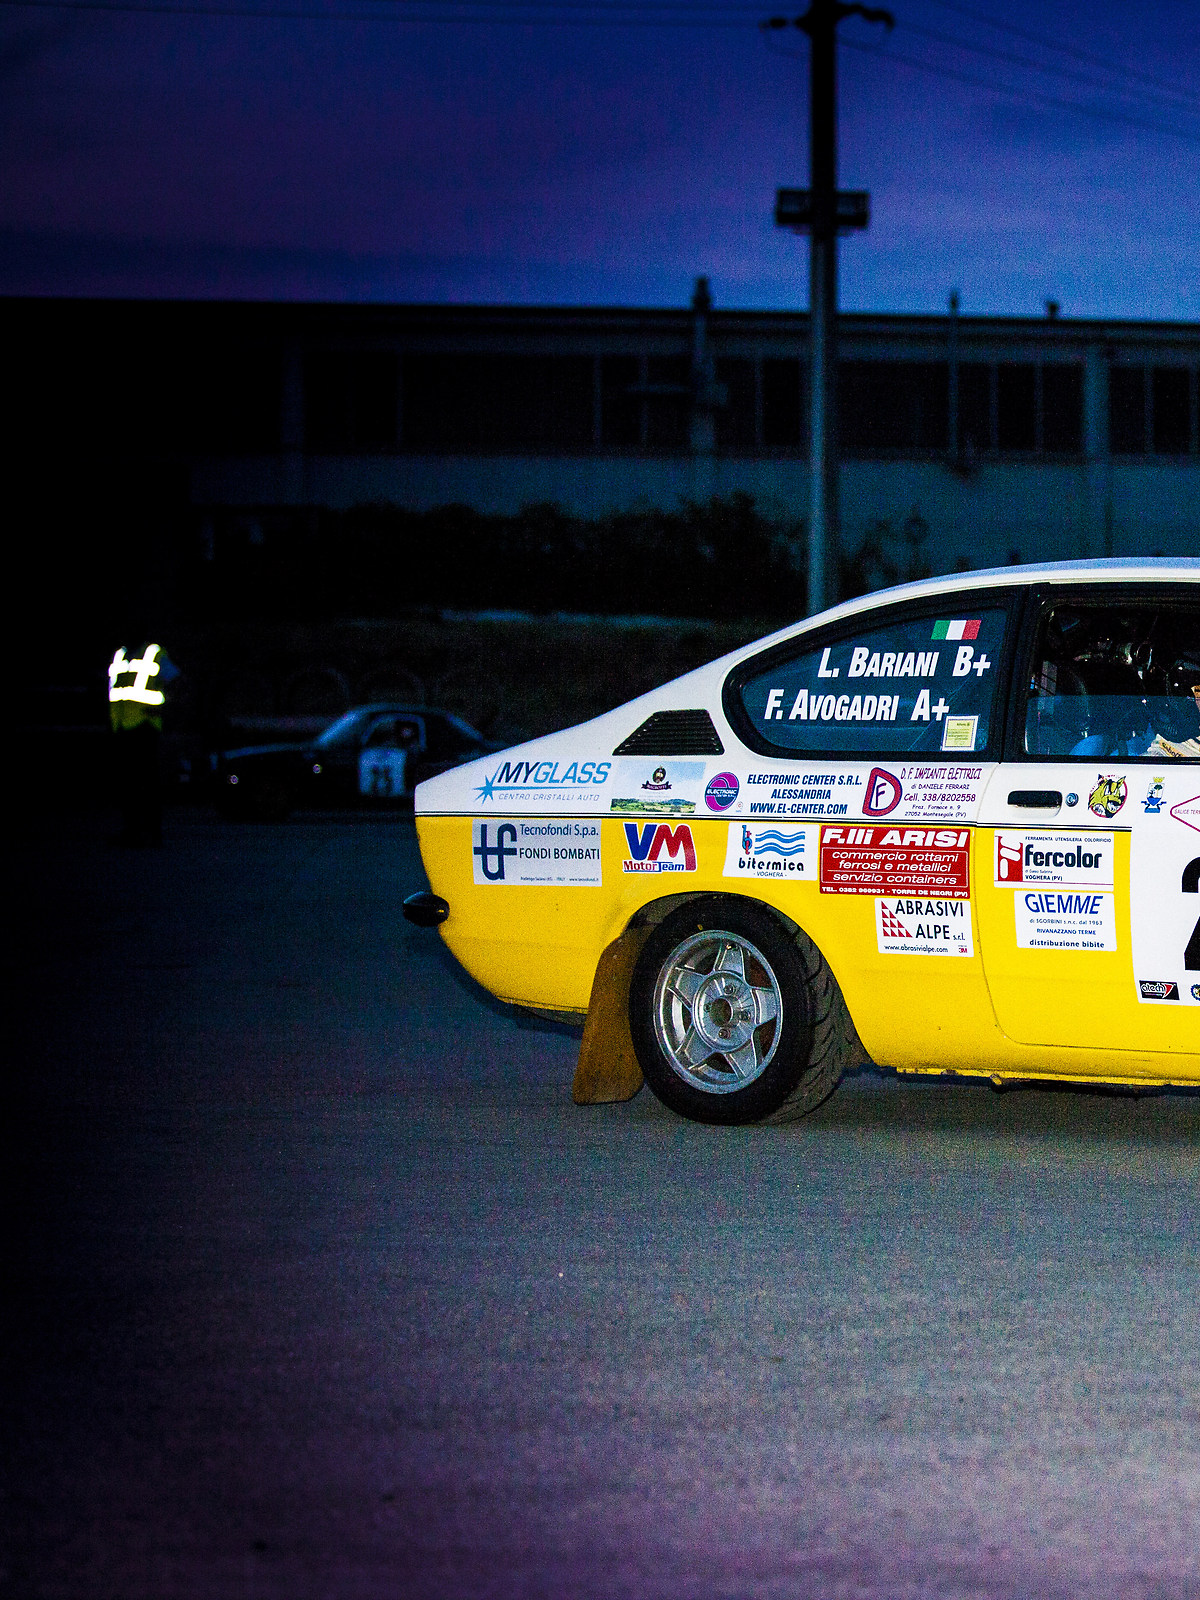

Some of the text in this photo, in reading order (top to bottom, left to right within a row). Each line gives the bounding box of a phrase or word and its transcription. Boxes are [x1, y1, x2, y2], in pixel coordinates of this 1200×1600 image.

[817, 646, 991, 678] L. BARIANI B+
[764, 689, 950, 721] F. AVOGADRI A+
[497, 762, 612, 784] MYGLASS
[914, 768, 947, 780] IMPIANTI
[948, 768, 982, 780] ELETTRICI
[747, 774, 862, 786] ELECTRONIC CENTER S.R.L.
[498, 793, 600, 802] CENTRO CRISTALLI AUTO
[771, 789, 831, 800] ALESSANDRIA
[922, 794, 976, 802] 338/8202558
[750, 804, 848, 815] WWW.EL-CENTER.COM
[520, 823, 599, 838] Tecnofondi S.p.a.
[822, 828, 968, 847] F.lli ARISI
[519, 847, 600, 860] FONDI BOMBATI
[832, 851, 959, 862] commercio rottami
[1025, 844, 1102, 868] fercolor
[738, 857, 804, 872] bitermica
[839, 860, 881, 870] ferrosi
[897, 862, 951, 872] metallici
[833, 873, 957, 884] servizio containers
[895, 900, 964, 917] ABRASIVI
[1025, 893, 1103, 915] GIEMME
[915, 924, 965, 940] ALPE s.r.l.
[1029, 939, 1080, 948] distribuzione
